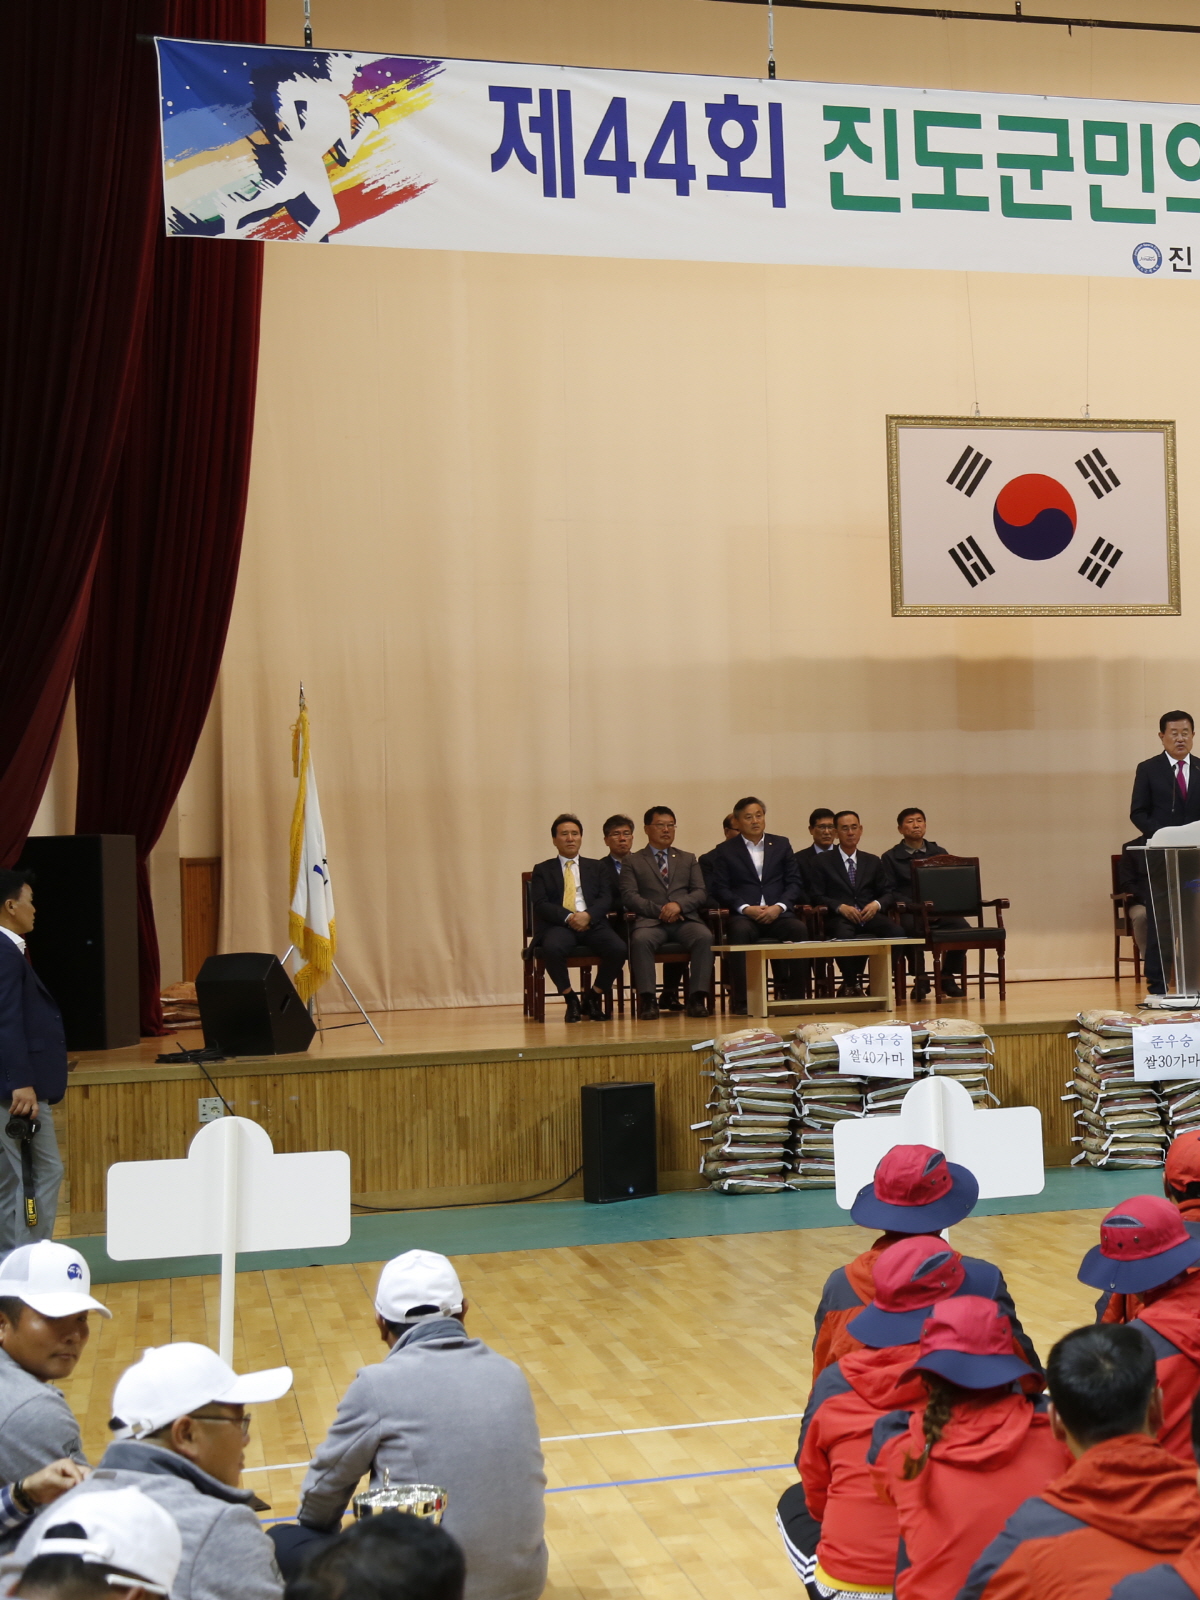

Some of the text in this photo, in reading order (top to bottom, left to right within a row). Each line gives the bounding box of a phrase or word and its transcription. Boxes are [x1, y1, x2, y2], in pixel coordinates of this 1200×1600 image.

[488, 85, 786, 209] 제44회
[1150, 1033, 1194, 1049] 준우승
[849, 1049, 905, 1067] 쌀40가마
[1143, 1053, 1200, 1070] 쌀30가마
